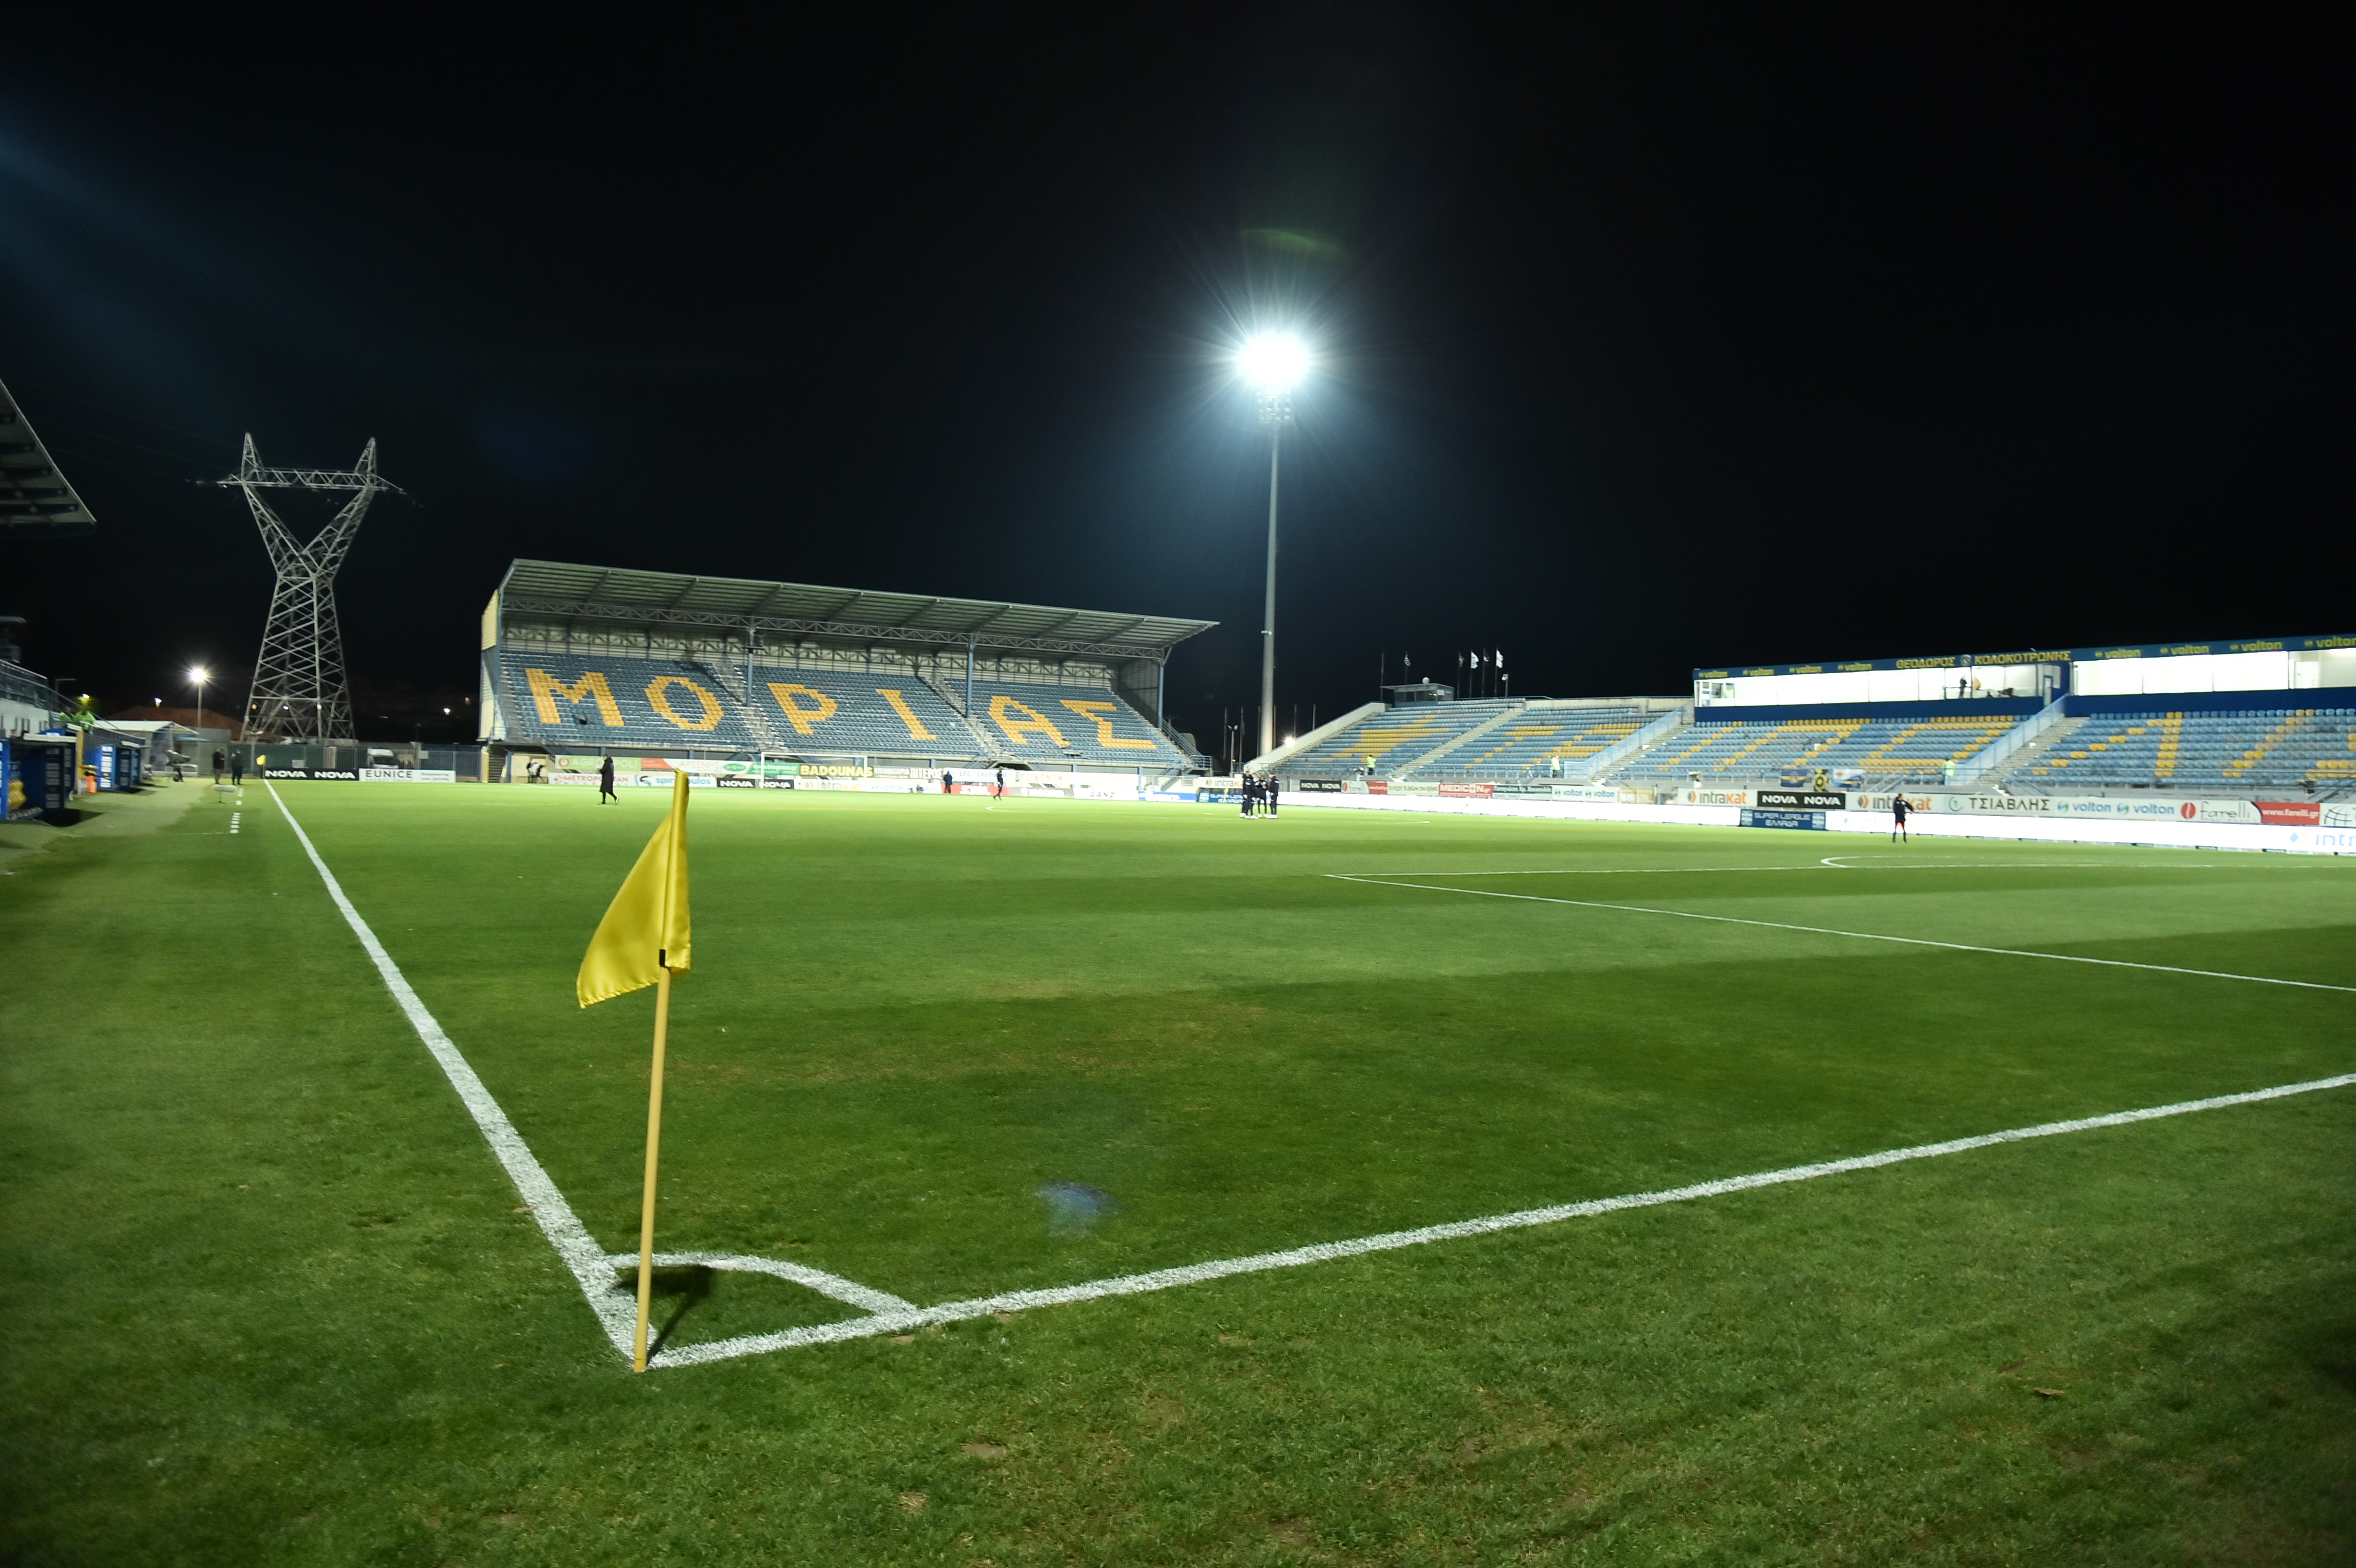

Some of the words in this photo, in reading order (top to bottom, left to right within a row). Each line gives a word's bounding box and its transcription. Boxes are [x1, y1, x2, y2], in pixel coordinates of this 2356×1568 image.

[2241, 641, 2282, 652] volton
[2316, 636, 2356, 648] volton
[2105, 648, 2141, 659] volton
[2171, 644, 2210, 655] volton
[1749, 668, 1774, 676] volton
[1796, 665, 1822, 674] volton
[1846, 663, 1873, 671] volton
[265, 770, 307, 778] NOVA
[315, 771, 356, 779] NOVA
[366, 770, 413, 778] EUNICE
[800, 765, 874, 777] BADOUNAS
[720, 779, 754, 787] NOVA
[759, 780, 791, 788] NOVA
[1563, 788, 1583, 796] volton
[1593, 789, 1614, 797] volton
[1700, 792, 1747, 805] intrakat
[1762, 795, 1798, 804] NOVA
[1804, 796, 1841, 806] NOVA
[1873, 794, 1931, 810] intkat
[1969, 797, 2050, 811] ΤΣΙΑΒΛΗΣ
[2073, 802, 2111, 812] volton
[2134, 804, 2174, 814] volton
[2199, 801, 2250, 820] farelli
